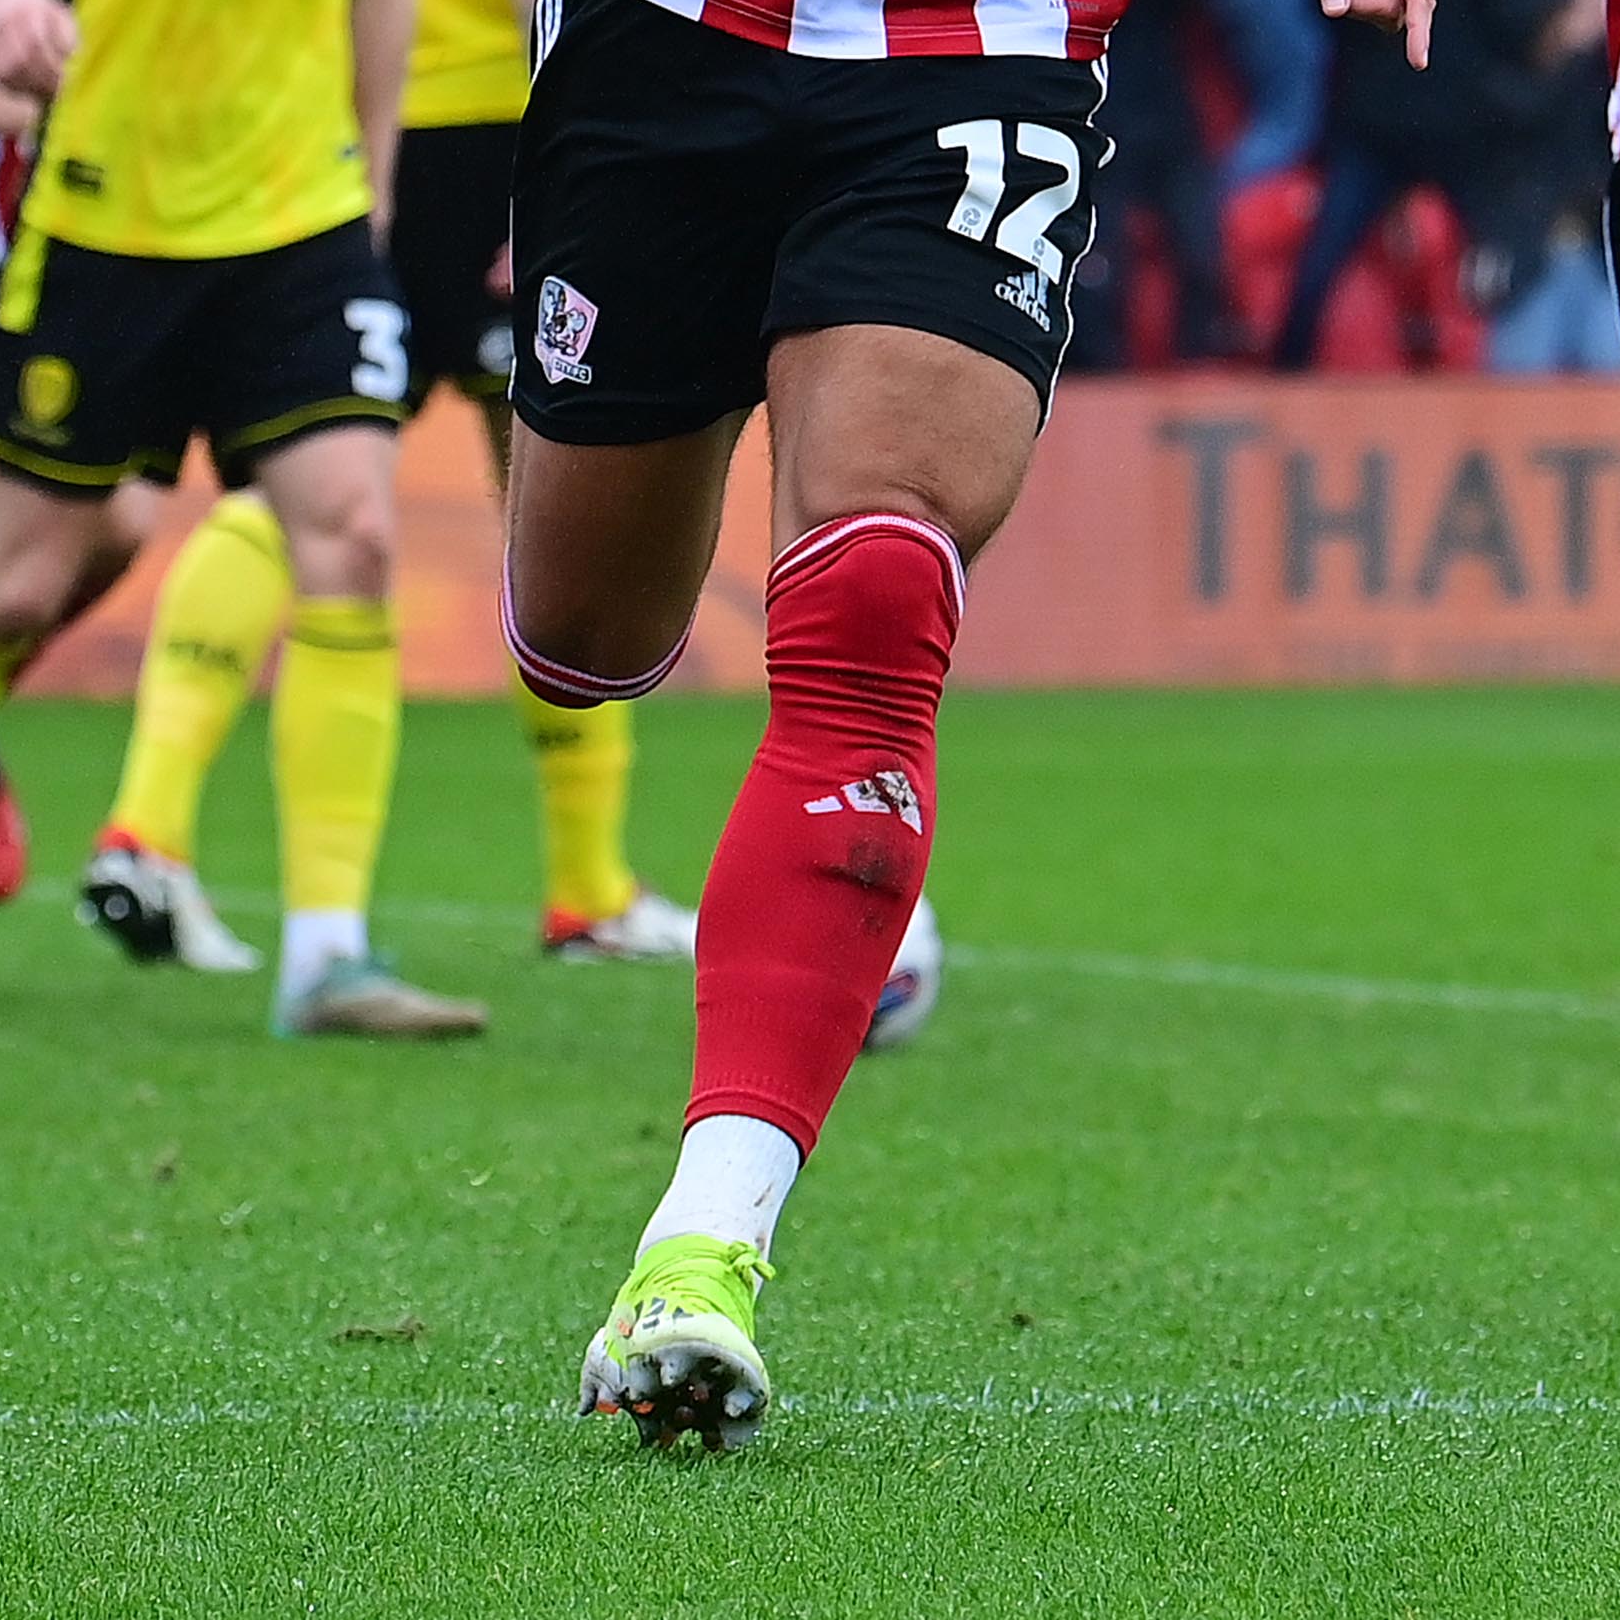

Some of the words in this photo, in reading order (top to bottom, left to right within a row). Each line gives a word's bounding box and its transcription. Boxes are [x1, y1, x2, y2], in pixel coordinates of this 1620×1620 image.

[937, 118, 1081, 285] 12
[343, 297, 411, 403] 3
[994, 282, 1051, 332] adidas
